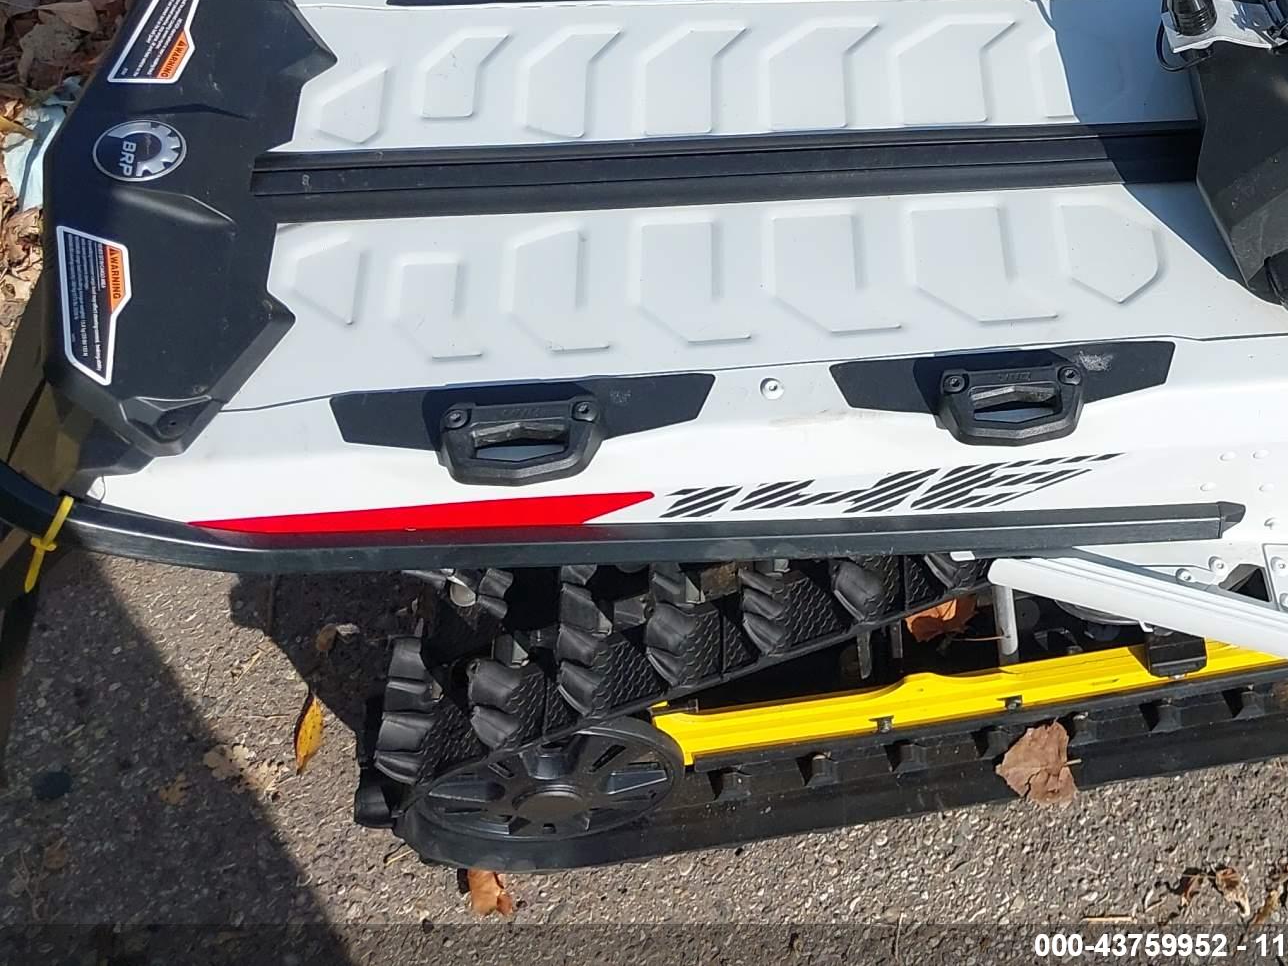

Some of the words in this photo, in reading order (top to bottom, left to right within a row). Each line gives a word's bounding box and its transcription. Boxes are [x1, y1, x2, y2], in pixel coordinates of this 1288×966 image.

[160, 46, 184, 77] WARNING
[118, 141, 137, 176] BRP
[110, 256, 121, 299] WARNING
